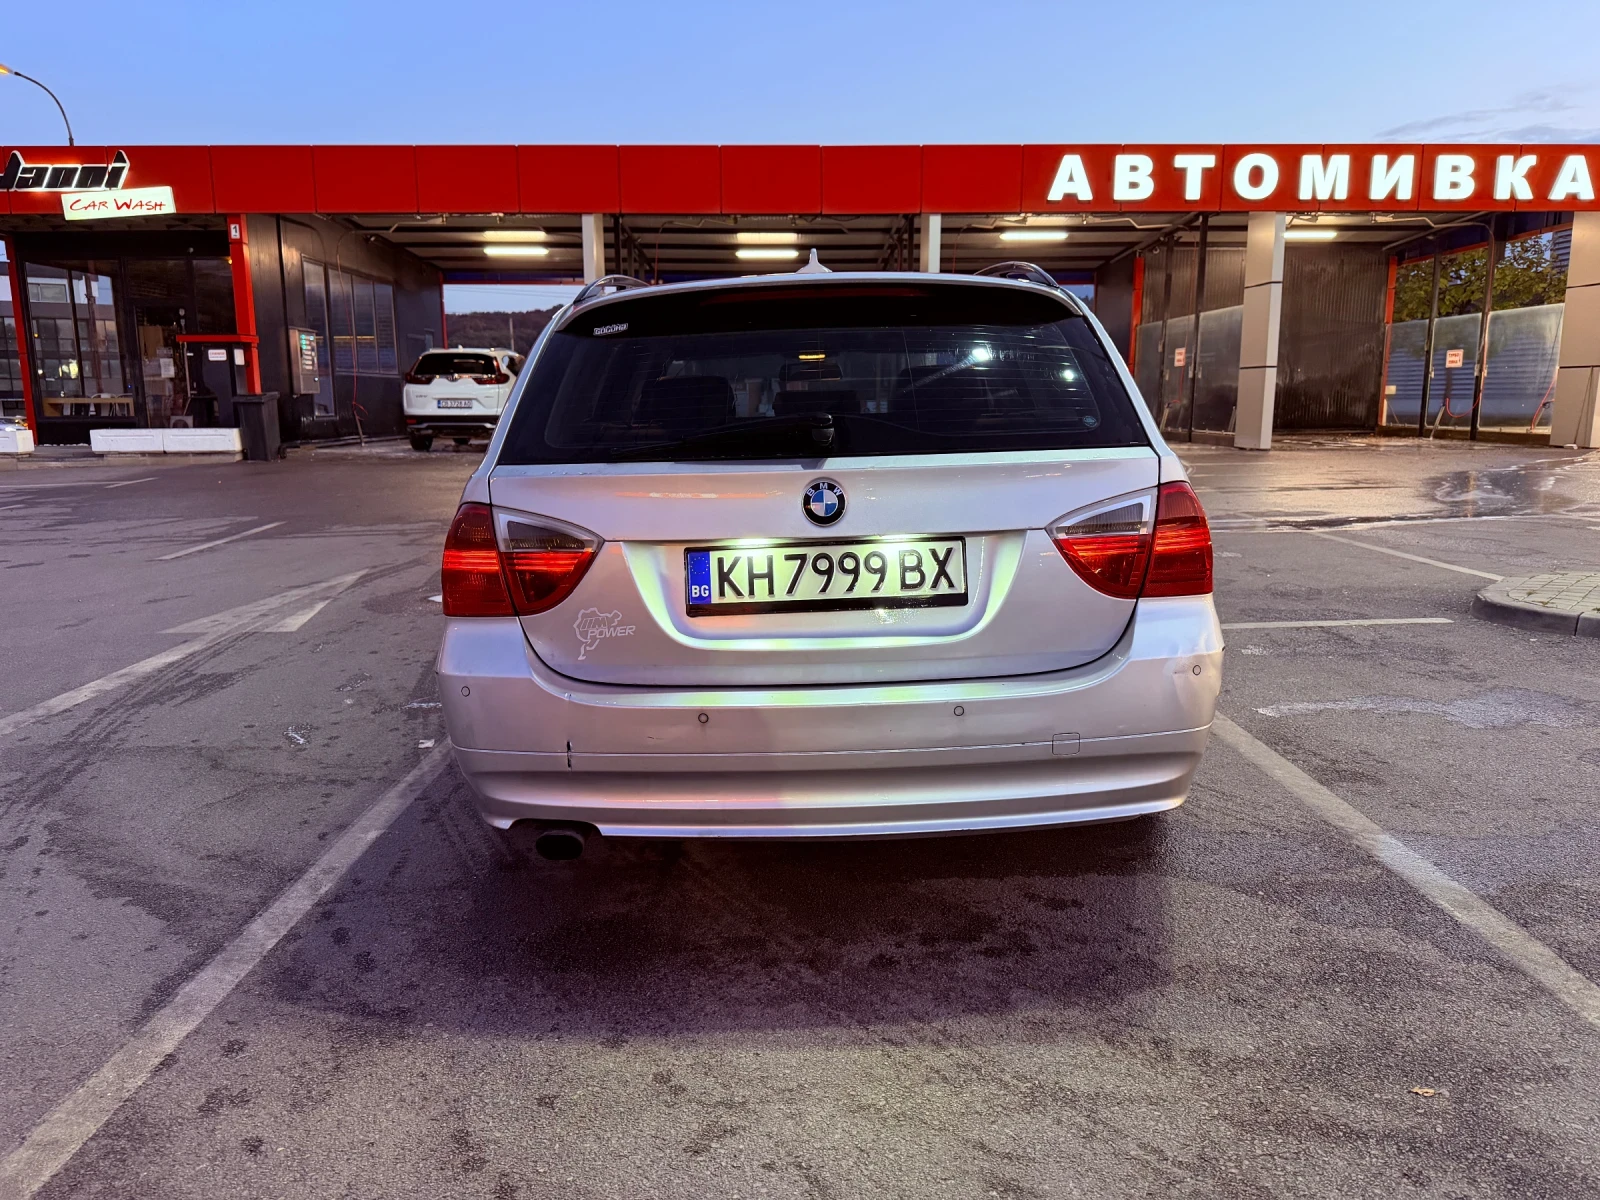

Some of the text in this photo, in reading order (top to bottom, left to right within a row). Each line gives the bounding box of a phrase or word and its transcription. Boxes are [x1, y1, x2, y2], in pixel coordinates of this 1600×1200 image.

[1046, 153, 1595, 201] АВТОМИВКА
[69, 198, 166, 211] CAR WASH
[806, 482, 843, 497] BMW
[716, 548, 956, 598] KH 7999 BX
[691, 585, 710, 598] BG
[587, 625, 636, 640] POWER
